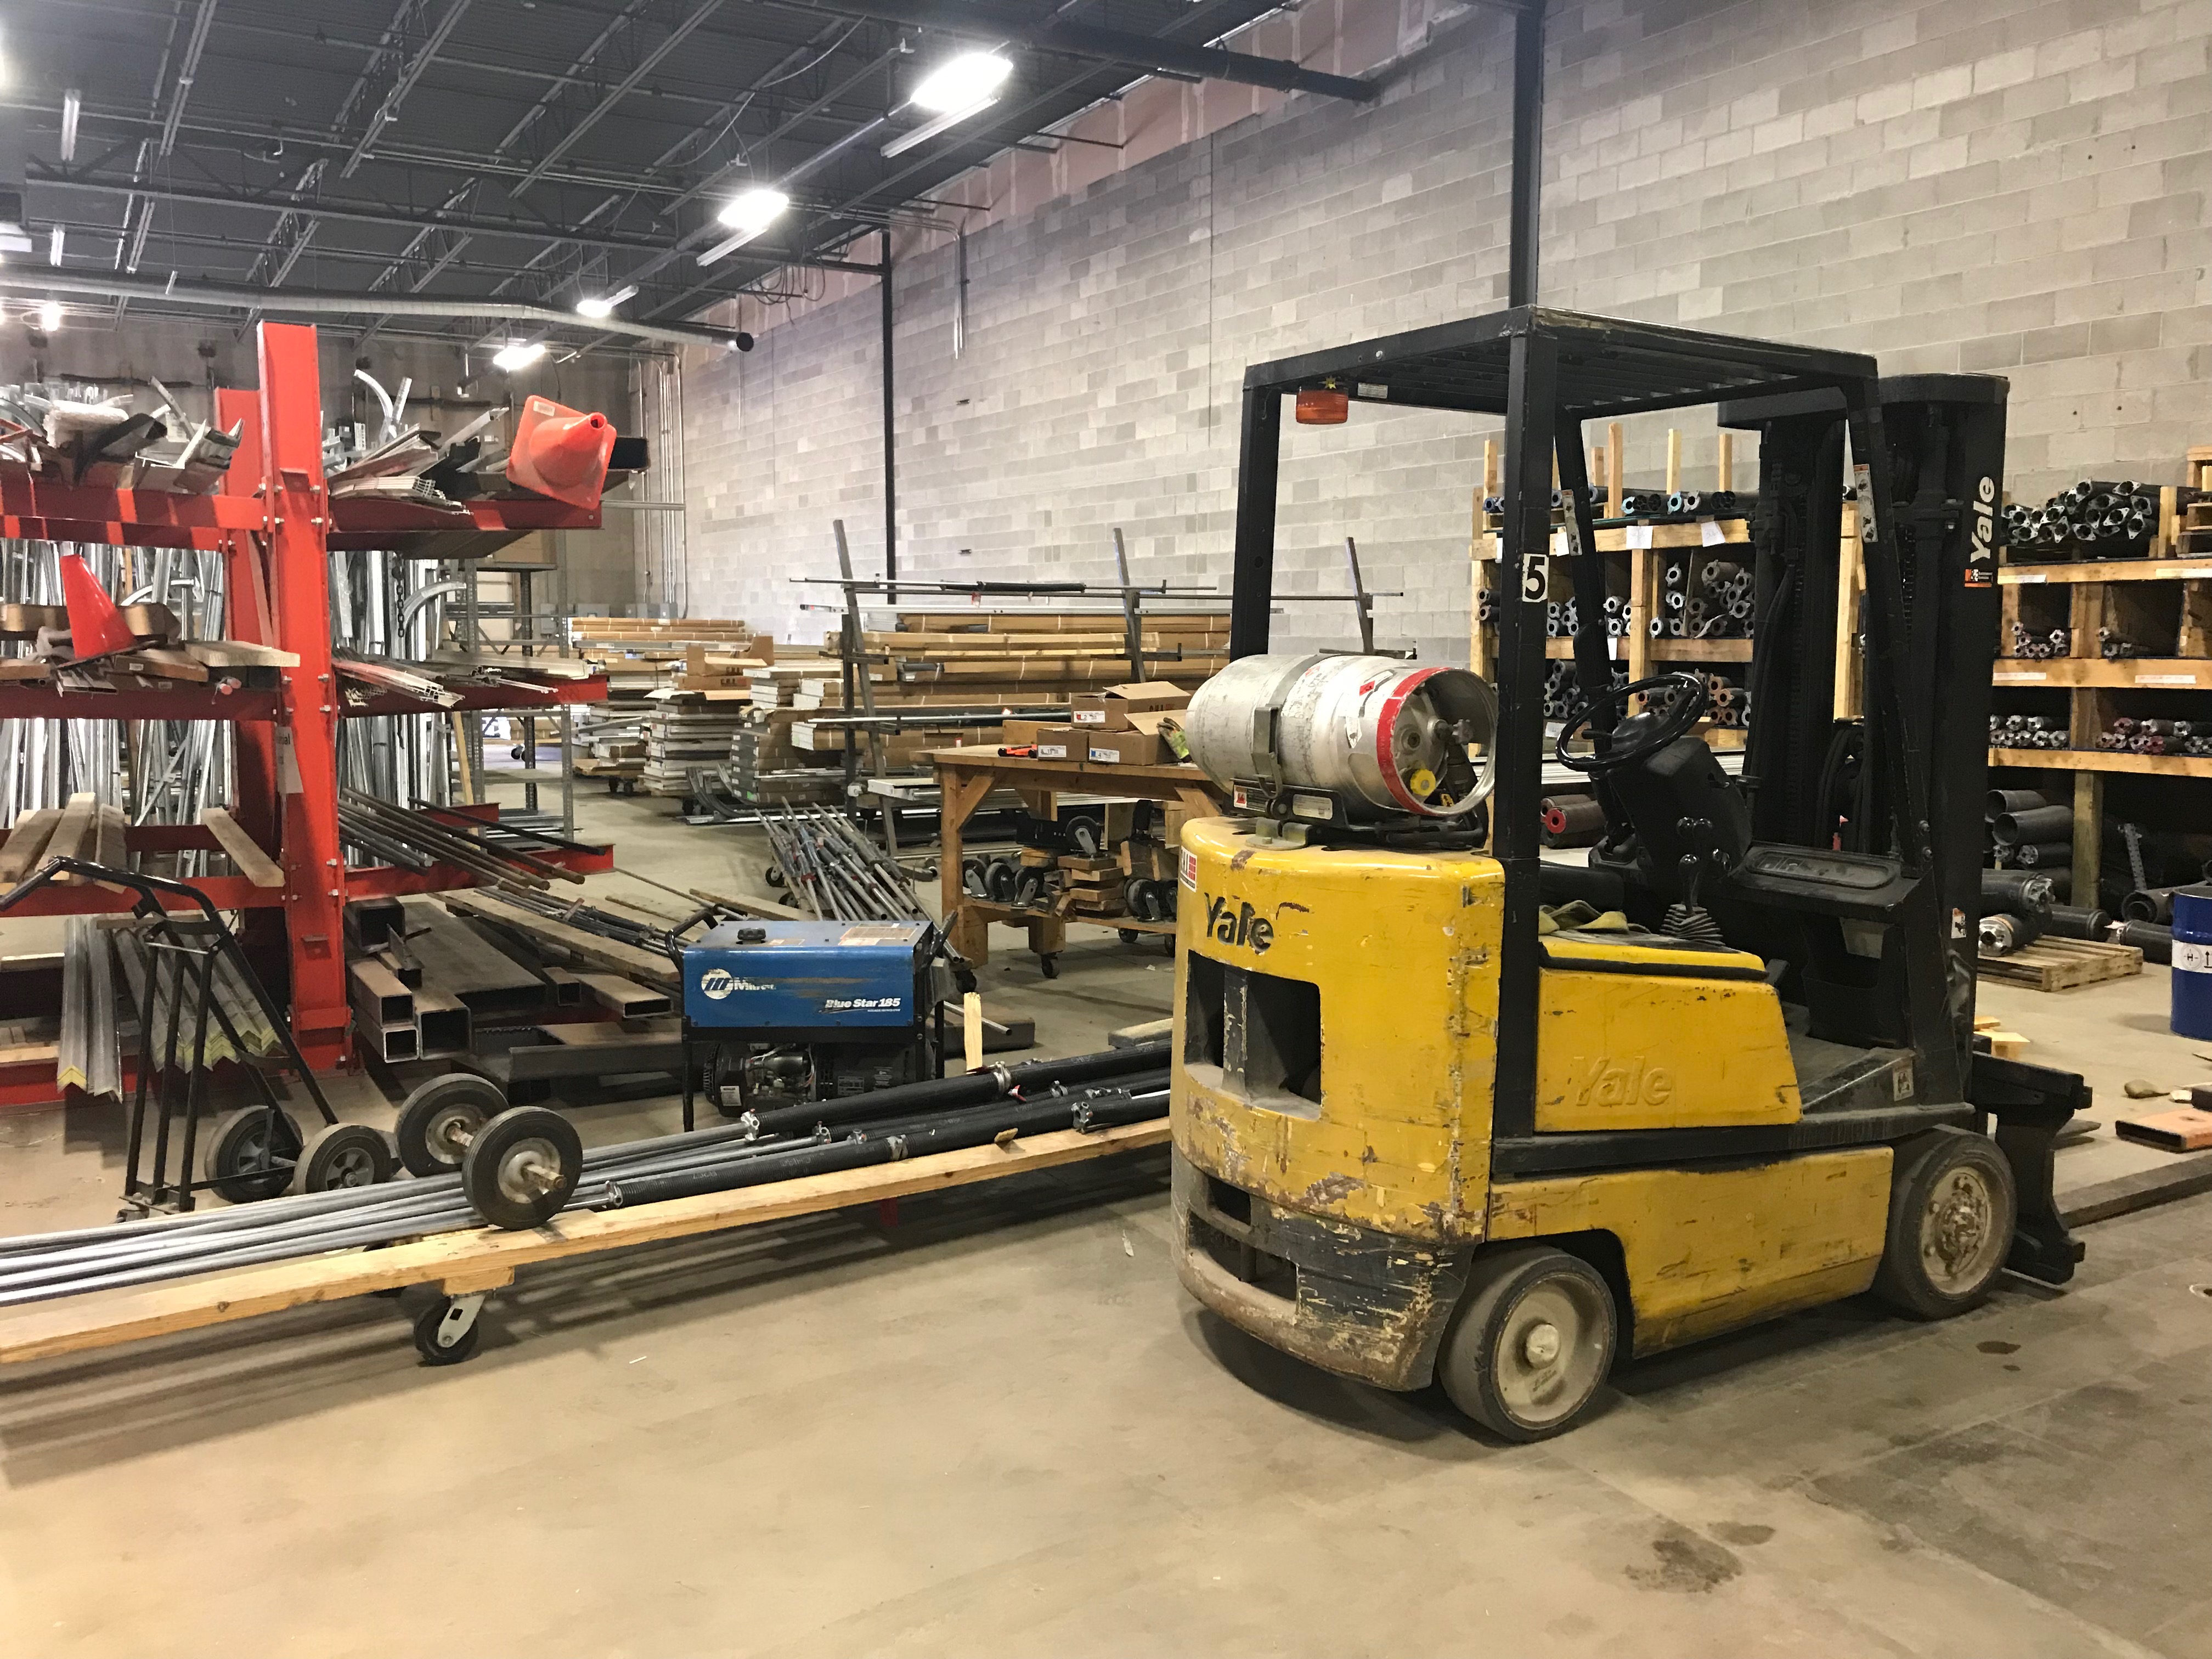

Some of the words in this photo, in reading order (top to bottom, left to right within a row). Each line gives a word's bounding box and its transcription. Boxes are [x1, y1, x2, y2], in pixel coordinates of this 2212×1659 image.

[1970, 476, 1995, 563] Yale
[1525, 555, 1546, 600] 5
[1204, 892, 1274, 953] Yale
[825, 999, 852, 1008] Blue
[853, 998, 878, 1007] Star
[878, 998, 901, 1007] 185
[1573, 1056, 1672, 1107] Yale
